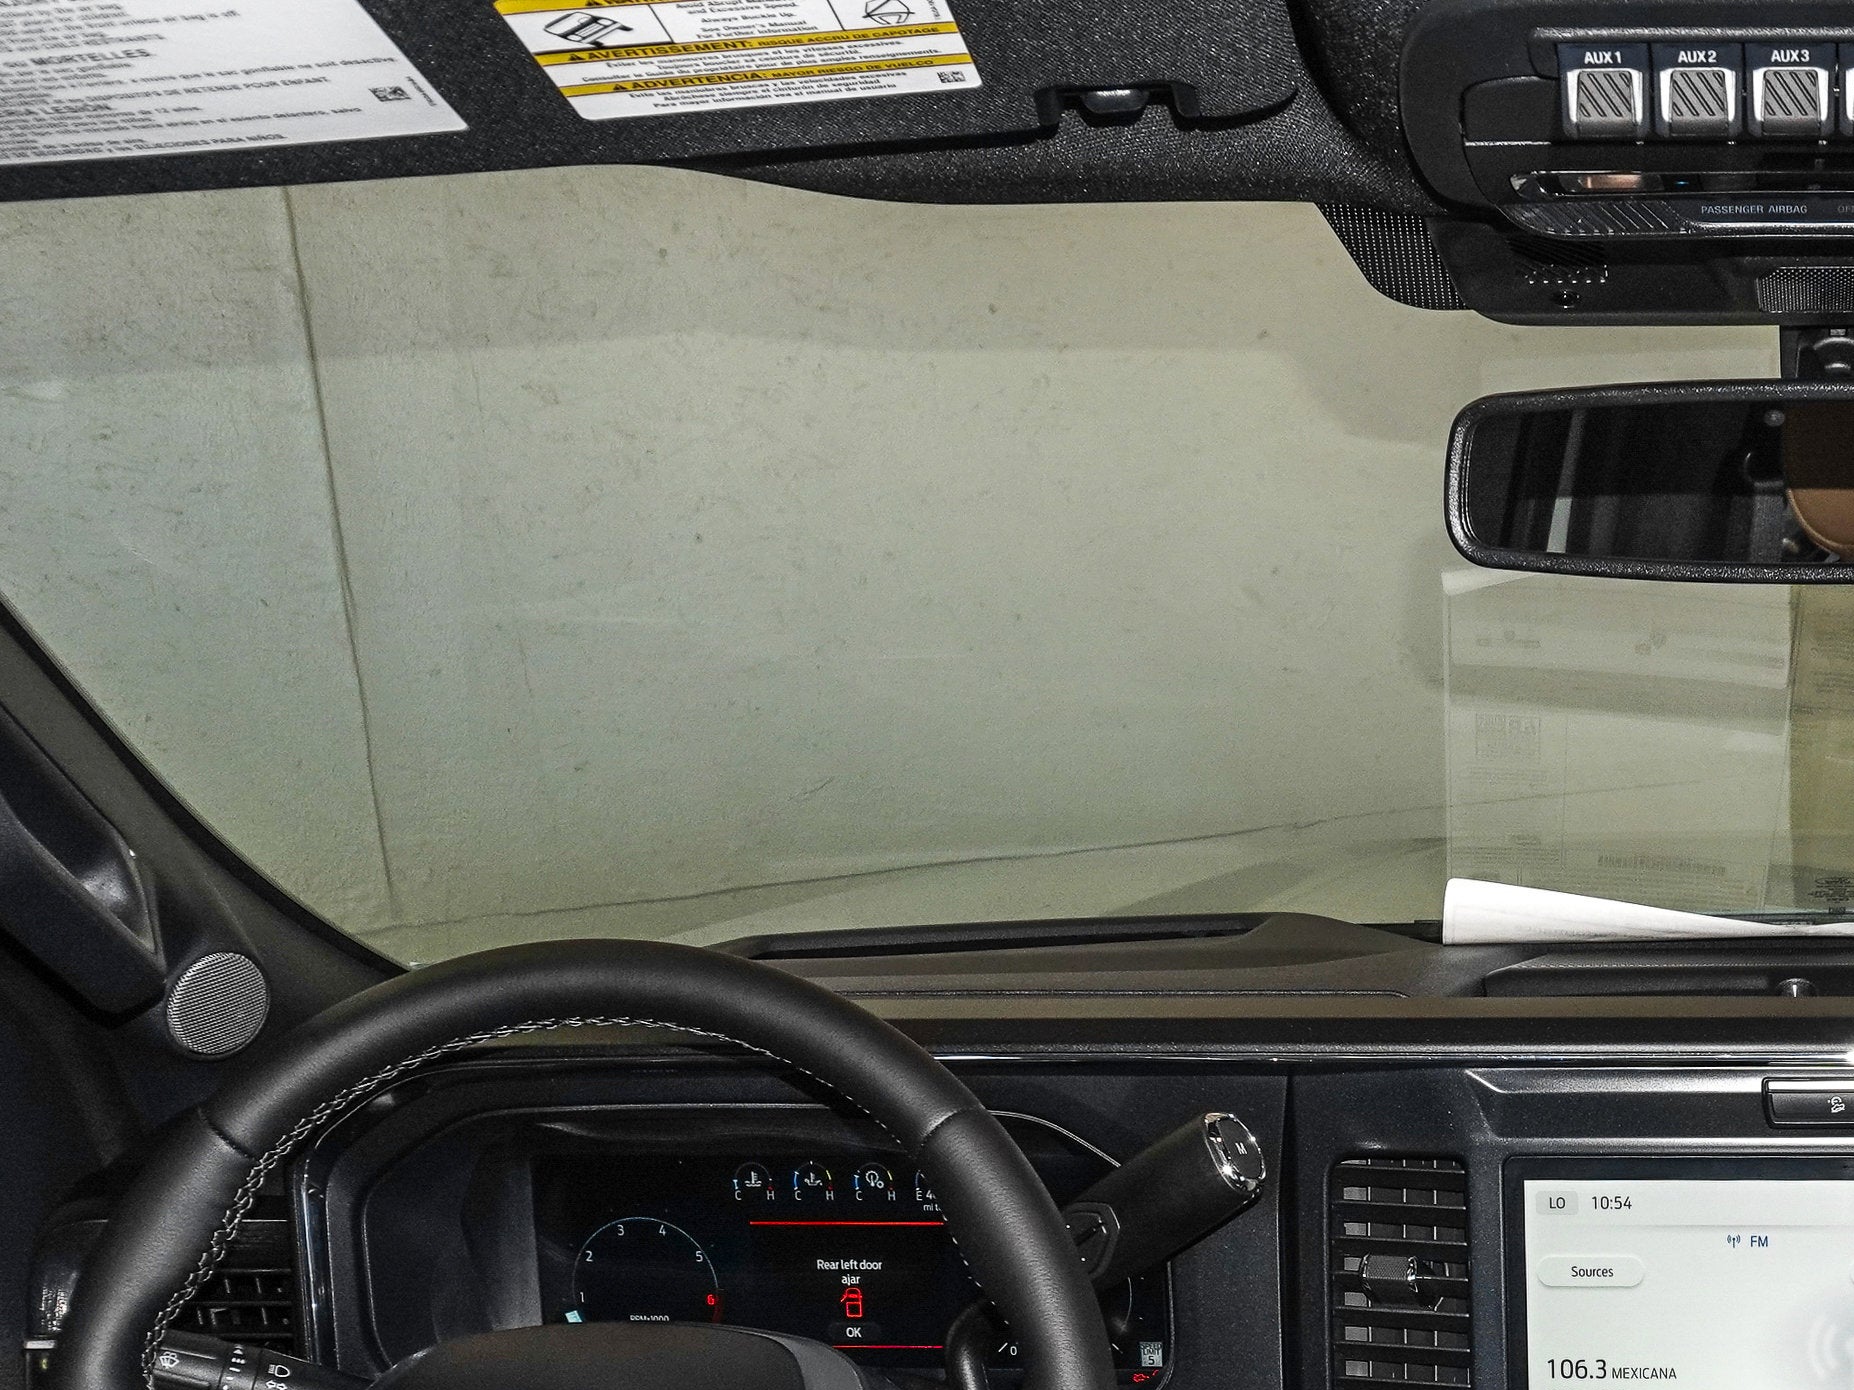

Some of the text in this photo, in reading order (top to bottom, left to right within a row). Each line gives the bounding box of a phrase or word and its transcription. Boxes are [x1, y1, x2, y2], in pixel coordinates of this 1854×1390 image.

[588, 40, 753, 61] AVERTISSEMENT:
[631, 71, 768, 89] ADVERTENCIA:
[1701, 205, 1808, 214] PASSENGER AIRBAG
[734, 1190, 742, 1201] C
[766, 1190, 775, 1201] H
[794, 1190, 802, 1201] C
[825, 1190, 835, 1201] H
[855, 1190, 863, 1201] C
[887, 1190, 897, 1201] H
[915, 1190, 923, 1201] E
[1549, 1197, 1566, 1209] LO
[1591, 1196, 1633, 1210] 10:54
[617, 1224, 625, 1236] 3
[658, 1224, 667, 1236] 4
[1750, 1235, 1769, 1248] FM
[585, 1250, 594, 1262] 2
[695, 1250, 704, 1262] 5
[816, 1259, 882, 1270] Rear left door
[1571, 1265, 1614, 1278] Sources
[841, 1274, 861, 1286] ajar
[579, 1291, 585, 1303] 1
[706, 1294, 715, 1306] 6
[845, 1327, 862, 1338] OK
[1148, 1355, 1155, 1366] 5
[1547, 1358, 1677, 1380] 106.3 MEXICANA
